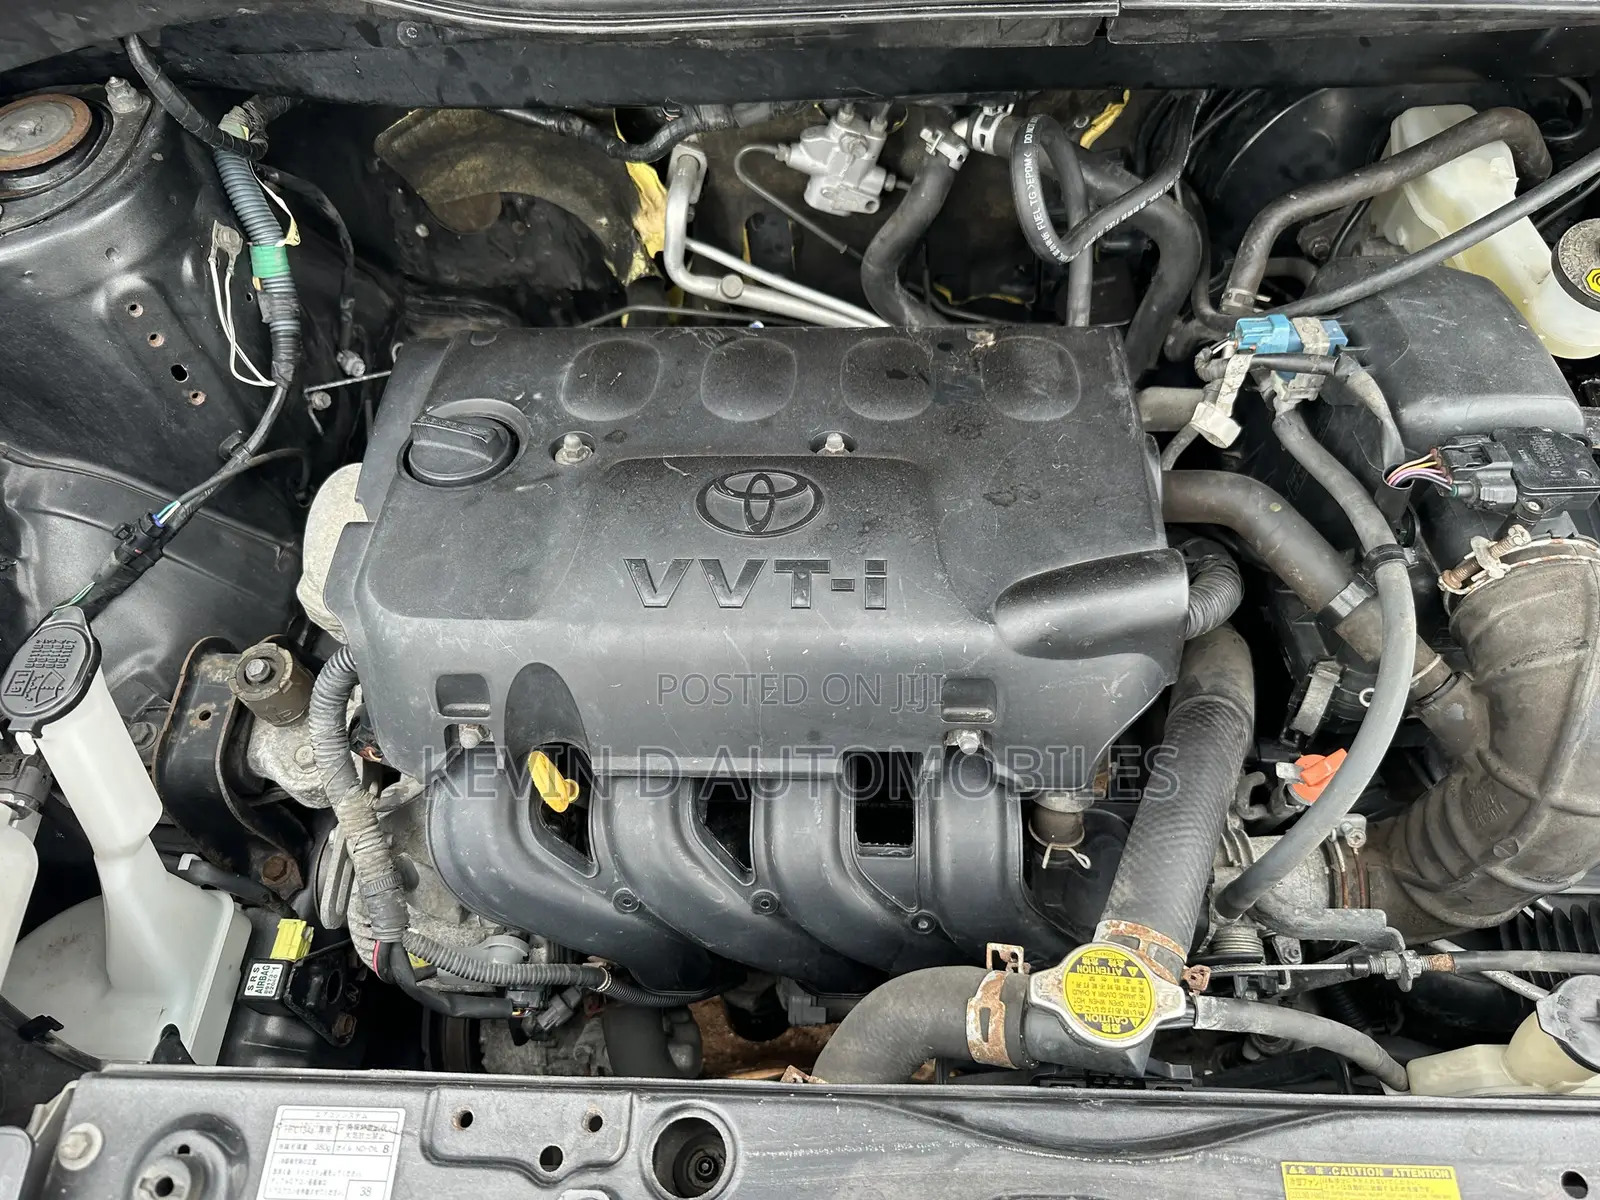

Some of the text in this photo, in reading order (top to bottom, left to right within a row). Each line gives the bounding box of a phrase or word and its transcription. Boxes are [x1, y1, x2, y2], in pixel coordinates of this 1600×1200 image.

[622, 558, 888, 610] VVT-i
[1076, 964, 1123, 976] ATTENTION
[254, 965, 271, 994] AIRBAG
[1108, 999, 1125, 1007] OPEN
[1128, 1001, 1147, 1009] NEVER
[1084, 1013, 1129, 1025] CAUTION
[382, 1144, 390, 1154] 8
[1331, 1166, 1384, 1177] CAUTION
[1392, 1168, 1450, 1179] ATTENTION
